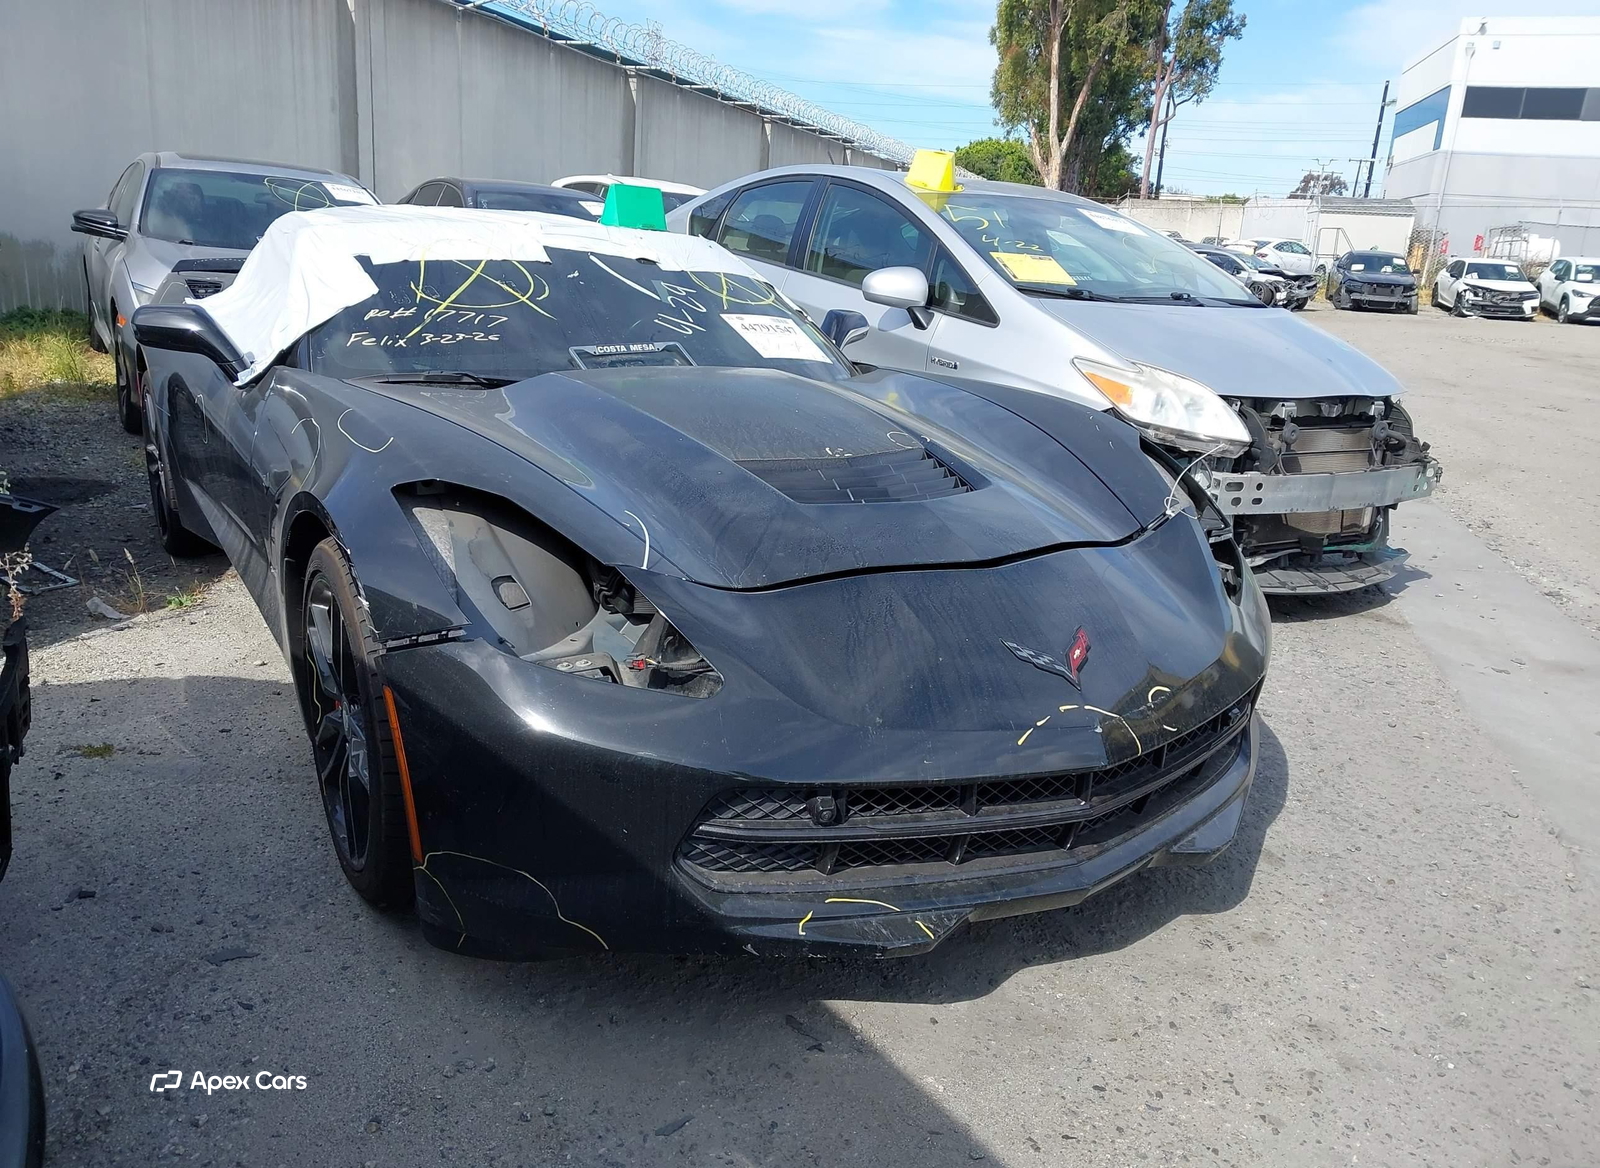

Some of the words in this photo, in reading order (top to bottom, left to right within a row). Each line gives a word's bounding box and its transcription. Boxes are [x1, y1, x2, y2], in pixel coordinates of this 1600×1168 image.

[944, 203, 1006, 230] 51
[346, 331, 407, 348] Felix
[597, 345, 627, 353] COSTA
[630, 343, 655, 351] MESA
